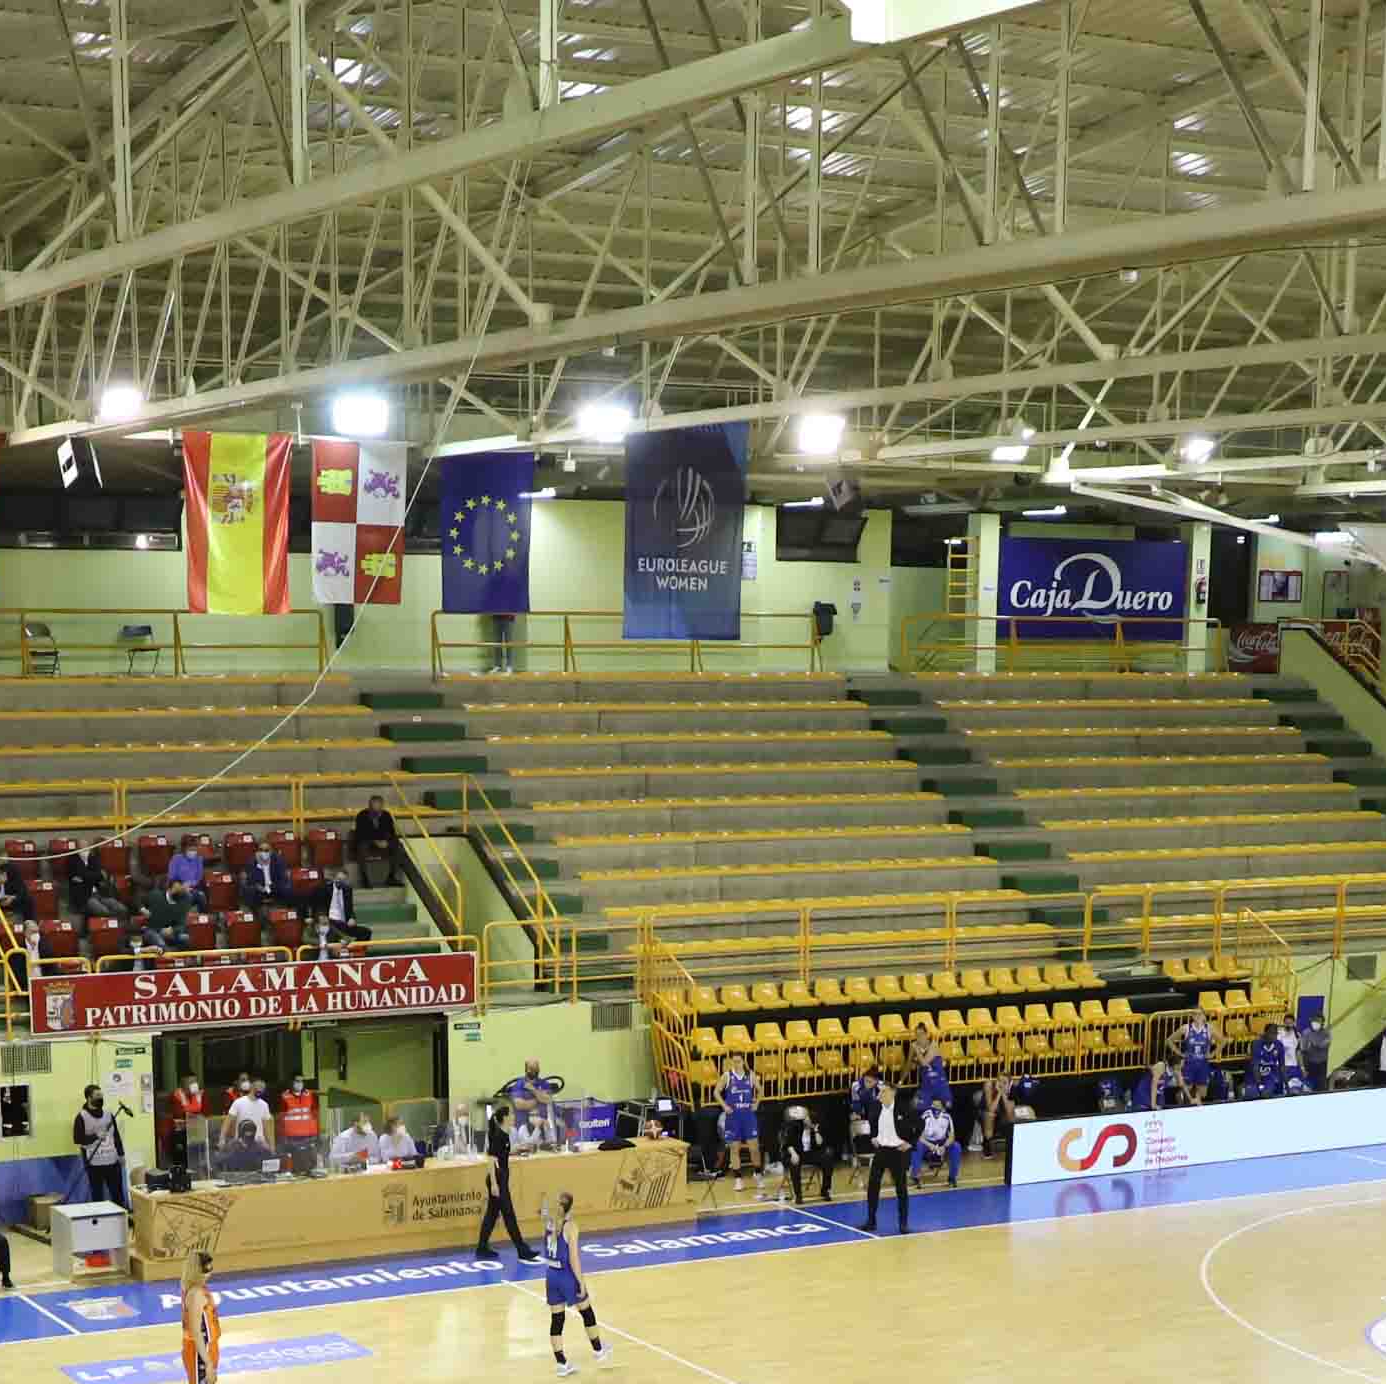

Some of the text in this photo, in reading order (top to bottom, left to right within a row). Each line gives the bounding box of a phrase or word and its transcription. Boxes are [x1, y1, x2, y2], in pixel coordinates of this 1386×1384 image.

[637, 556, 730, 576] EUROLEAGUE
[656, 574, 709, 592] WOMEN
[1010, 552, 1174, 622] Caja Duero
[133, 959, 431, 1001] SALAMANCA
[84, 983, 466, 1028] PATRIMONIO DE LA HUMANIDAD
[413, 1191, 482, 1208] Ayuntamiento
[413, 1206, 482, 1221] de Salamanca
[581, 1219, 832, 1258] Salamanca
